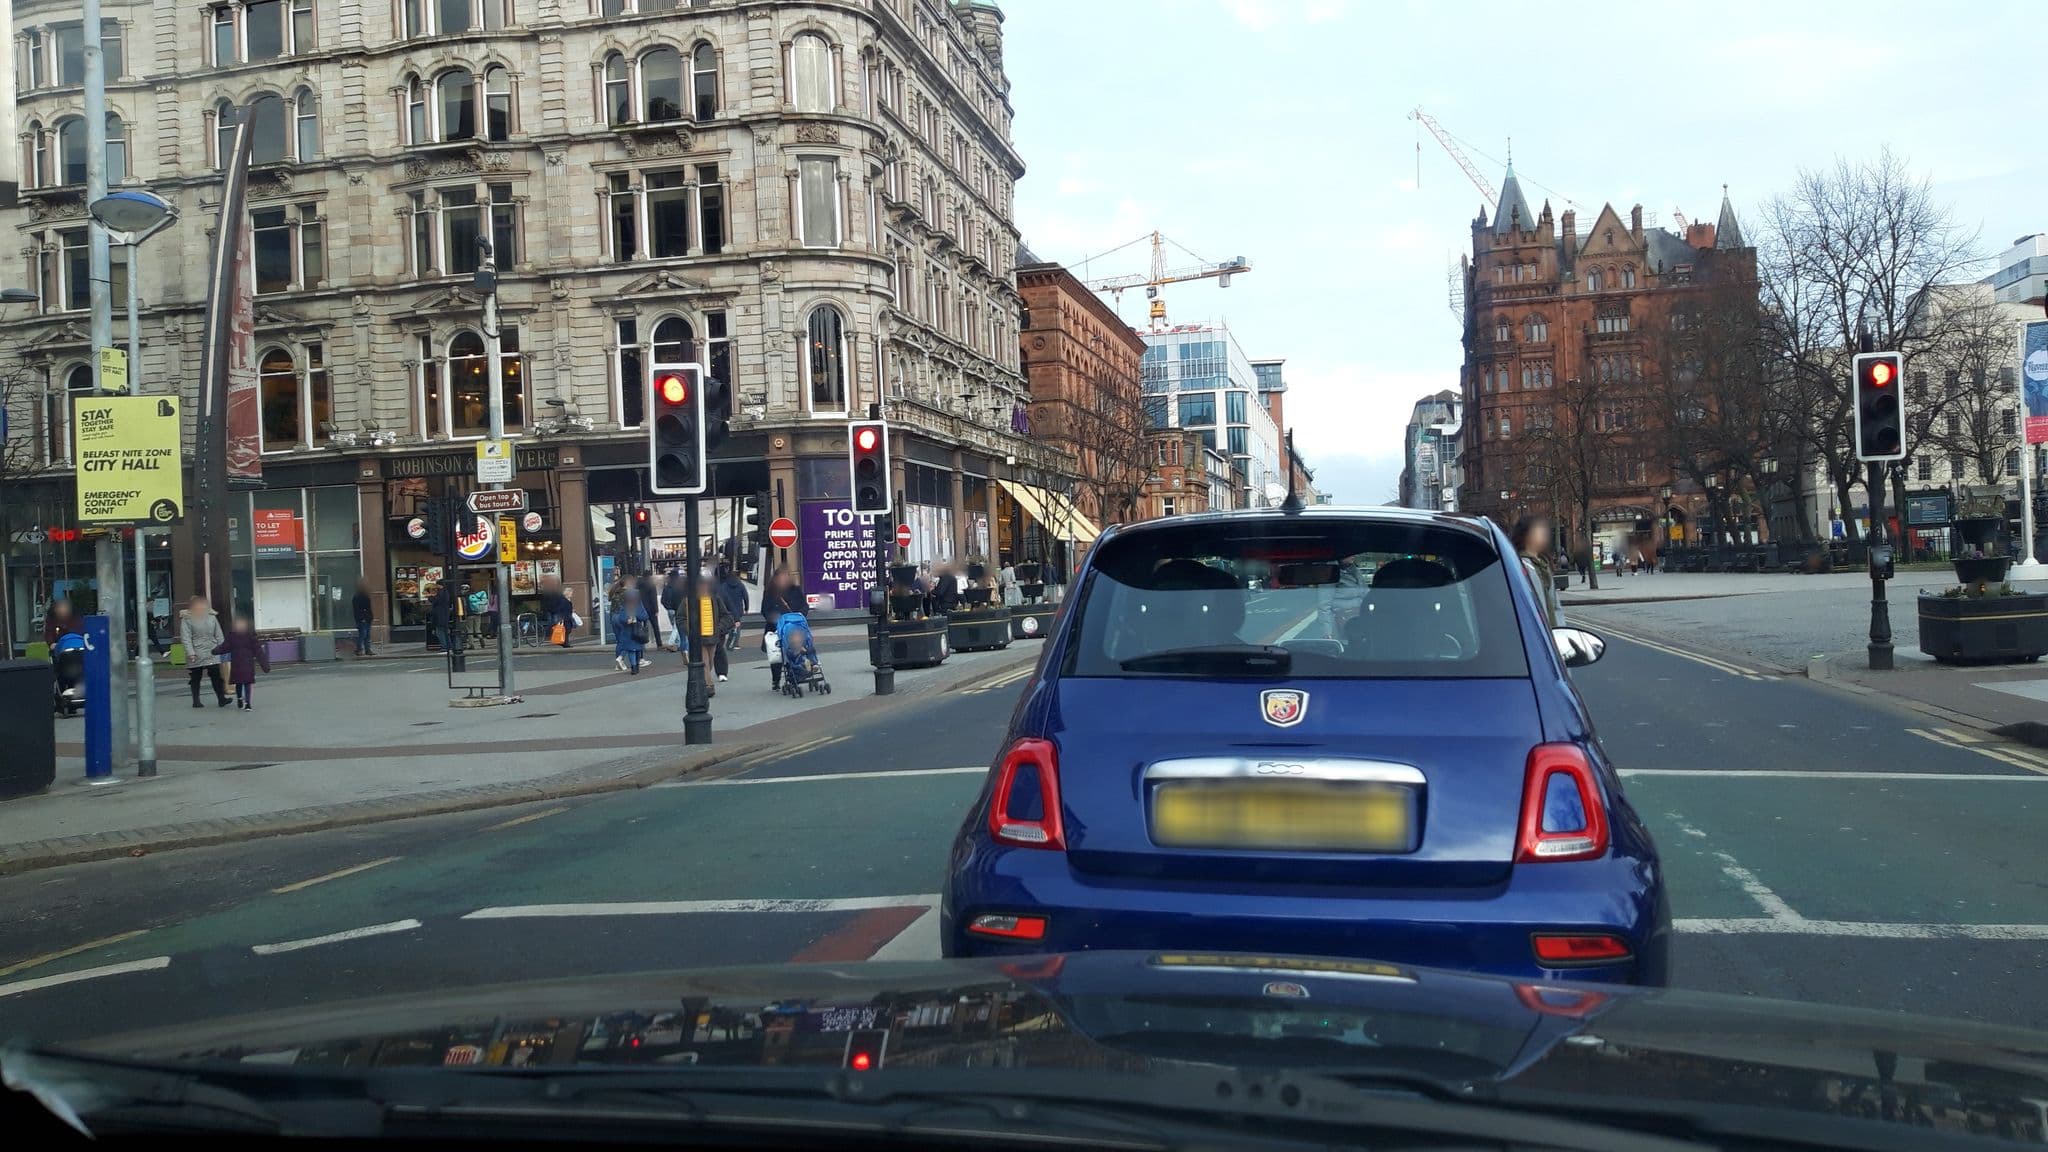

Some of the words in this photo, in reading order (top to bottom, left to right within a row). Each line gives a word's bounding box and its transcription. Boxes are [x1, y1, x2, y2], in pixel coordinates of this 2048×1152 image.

[81, 408, 113, 422] STAY
[81, 418, 114, 427] TOGETHER
[82, 450, 121, 459] BELFAST
[122, 449, 143, 458] NITE
[145, 448, 173, 457] ZONE
[84, 460, 117, 472] CITY
[122, 458, 160, 471] HALL
[392, 456, 462, 476] ROBINSON
[466, 457, 474, 472] &
[84, 491, 141, 500] EMERGENCY
[480, 494, 497, 503] Open
[498, 494, 510, 502] top
[823, 508, 854, 526] TO
[824, 530, 854, 539] PRIME
[456, 530, 488, 551] KING
[824, 561, 855, 571] (STPP)
[822, 572, 842, 581] ALL
[839, 583, 858, 591] EPC
[1258, 762, 1304, 774] 500
